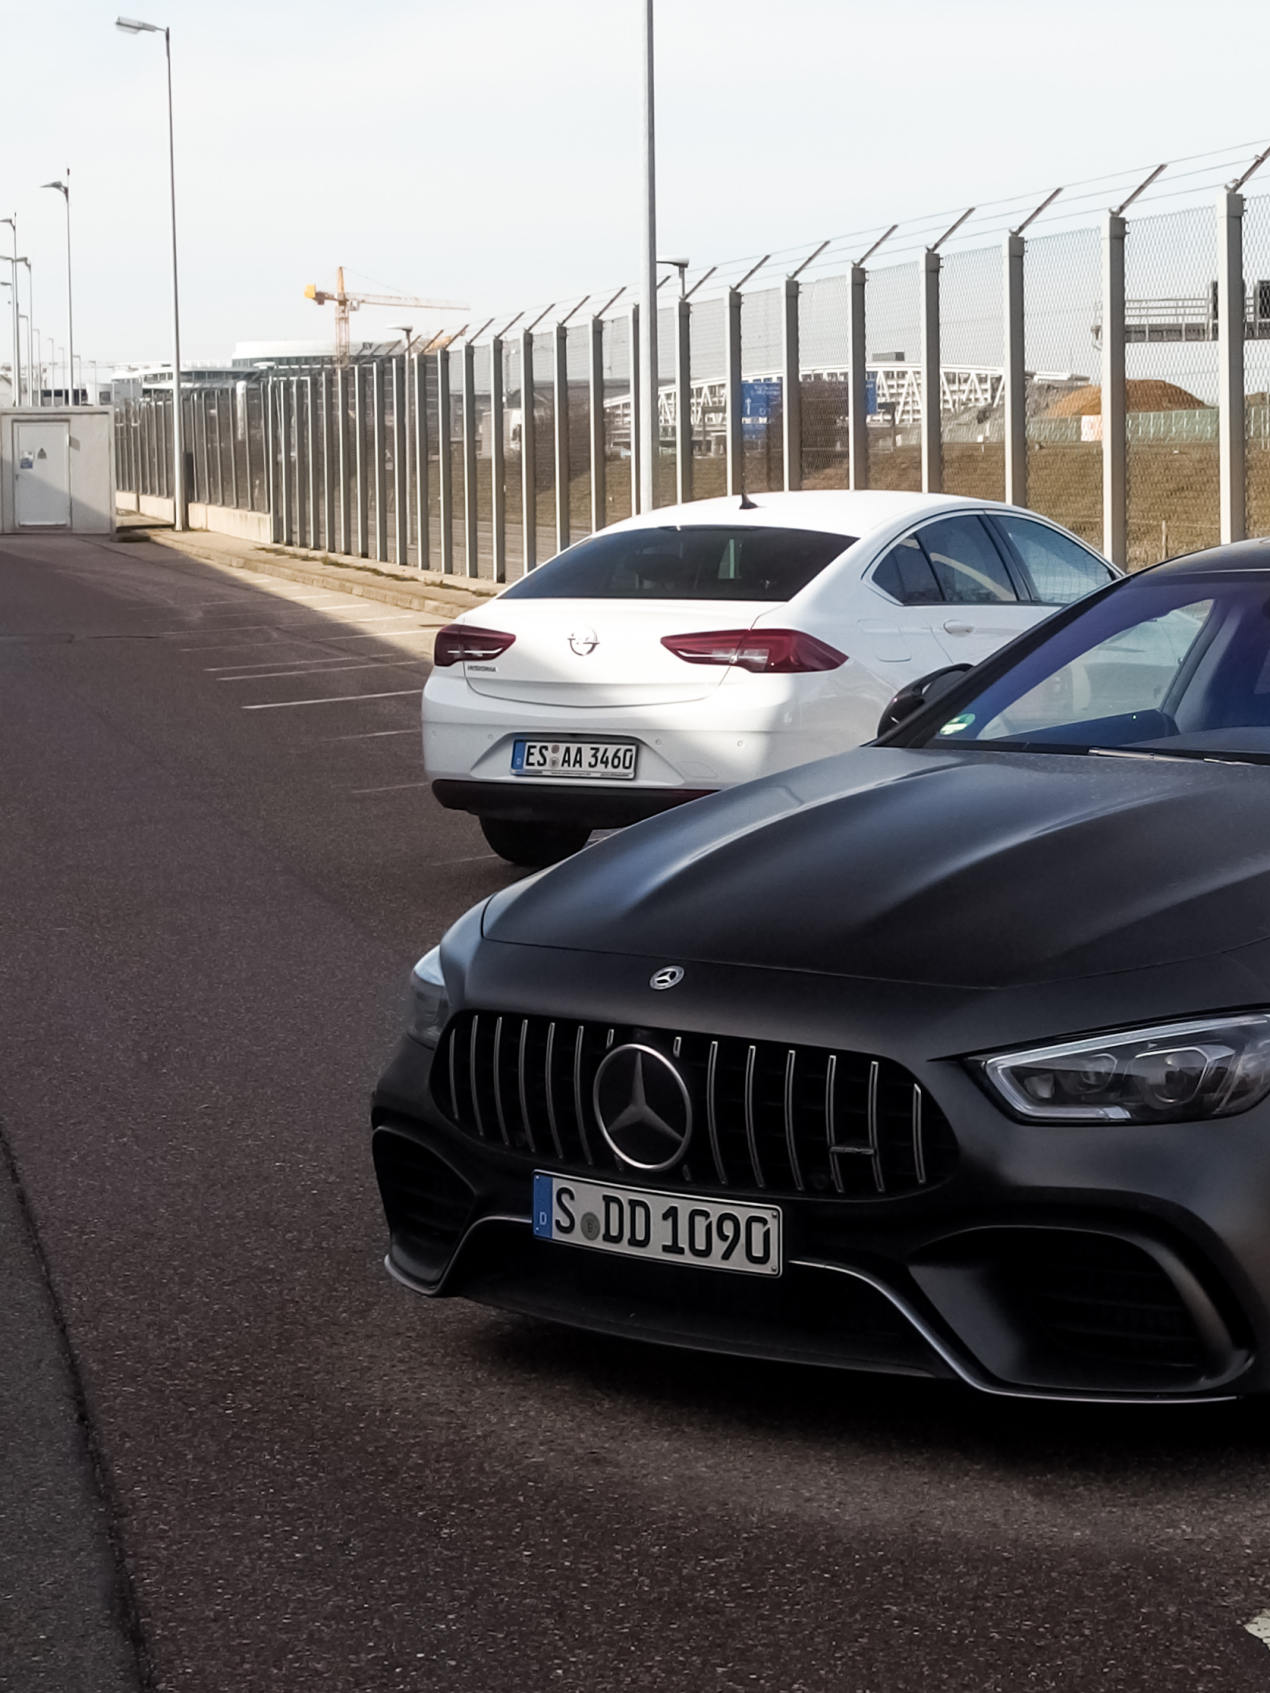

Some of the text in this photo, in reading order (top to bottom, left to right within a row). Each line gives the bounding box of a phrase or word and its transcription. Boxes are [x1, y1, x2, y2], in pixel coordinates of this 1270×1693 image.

[525, 745, 634, 770] ES AA 3460
[539, 1212, 547, 1226] D
[555, 1186, 771, 1265] S DD 1090
